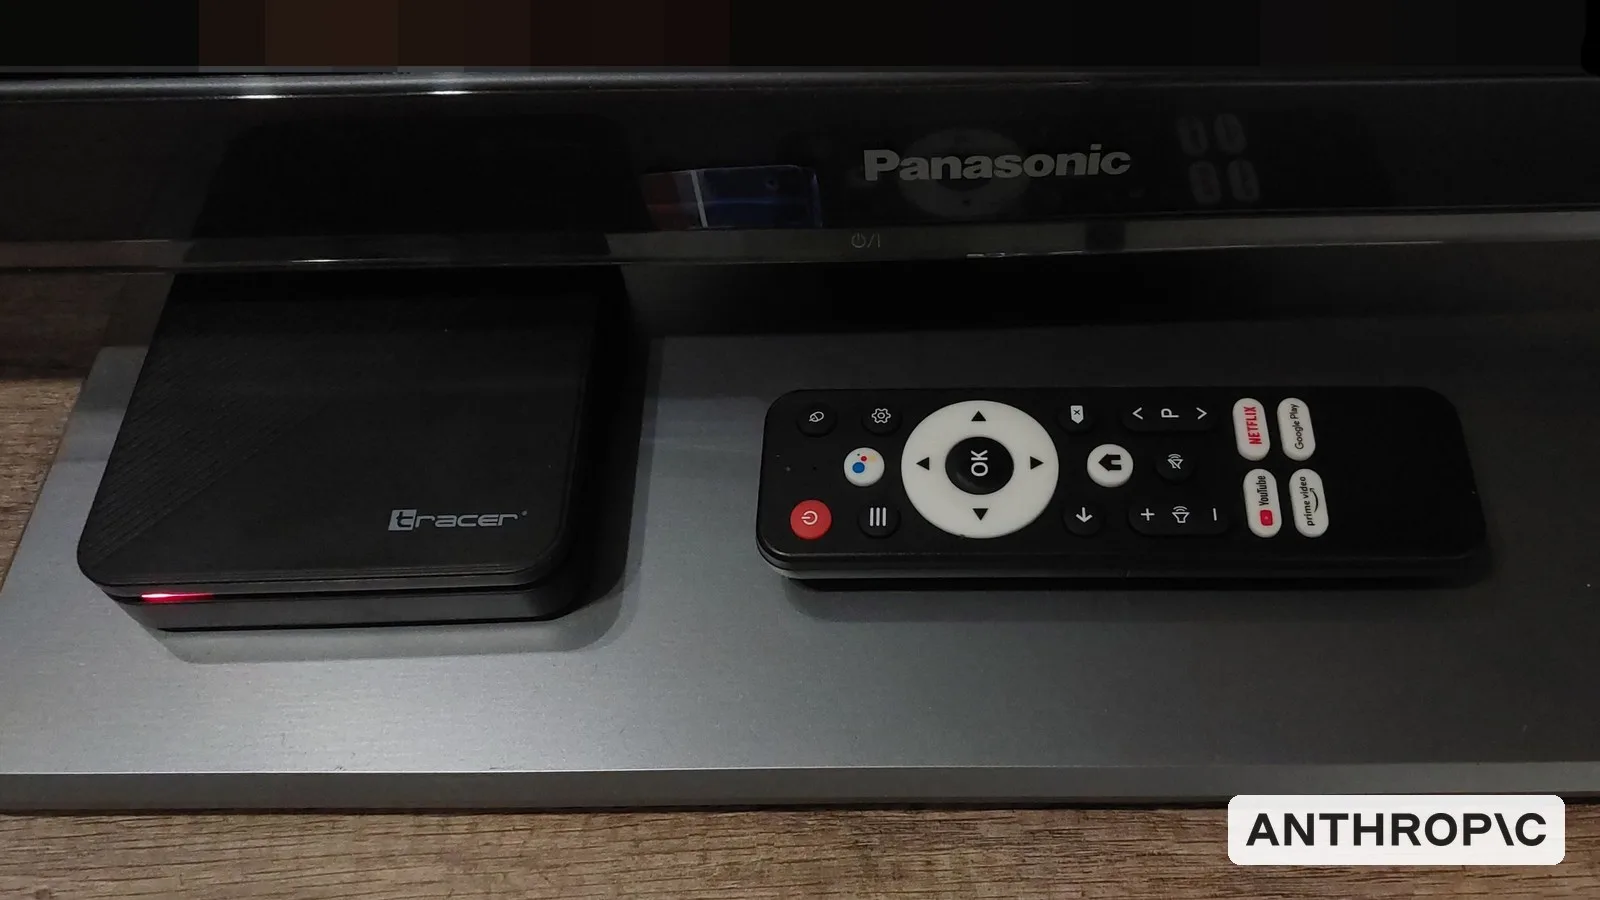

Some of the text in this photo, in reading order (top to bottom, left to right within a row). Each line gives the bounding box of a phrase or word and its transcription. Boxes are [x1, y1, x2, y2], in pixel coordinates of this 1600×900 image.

[863, 143, 1132, 182] Panasonic
[1160, 407, 1180, 419] P
[1243, 406, 1262, 445] NETFLIX
[1289, 403, 1304, 450] Google Play
[970, 449, 989, 477] OK
[1256, 475, 1269, 506] YouTube
[1299, 476, 1316, 527] prime video
[388, 509, 519, 532] tracer
